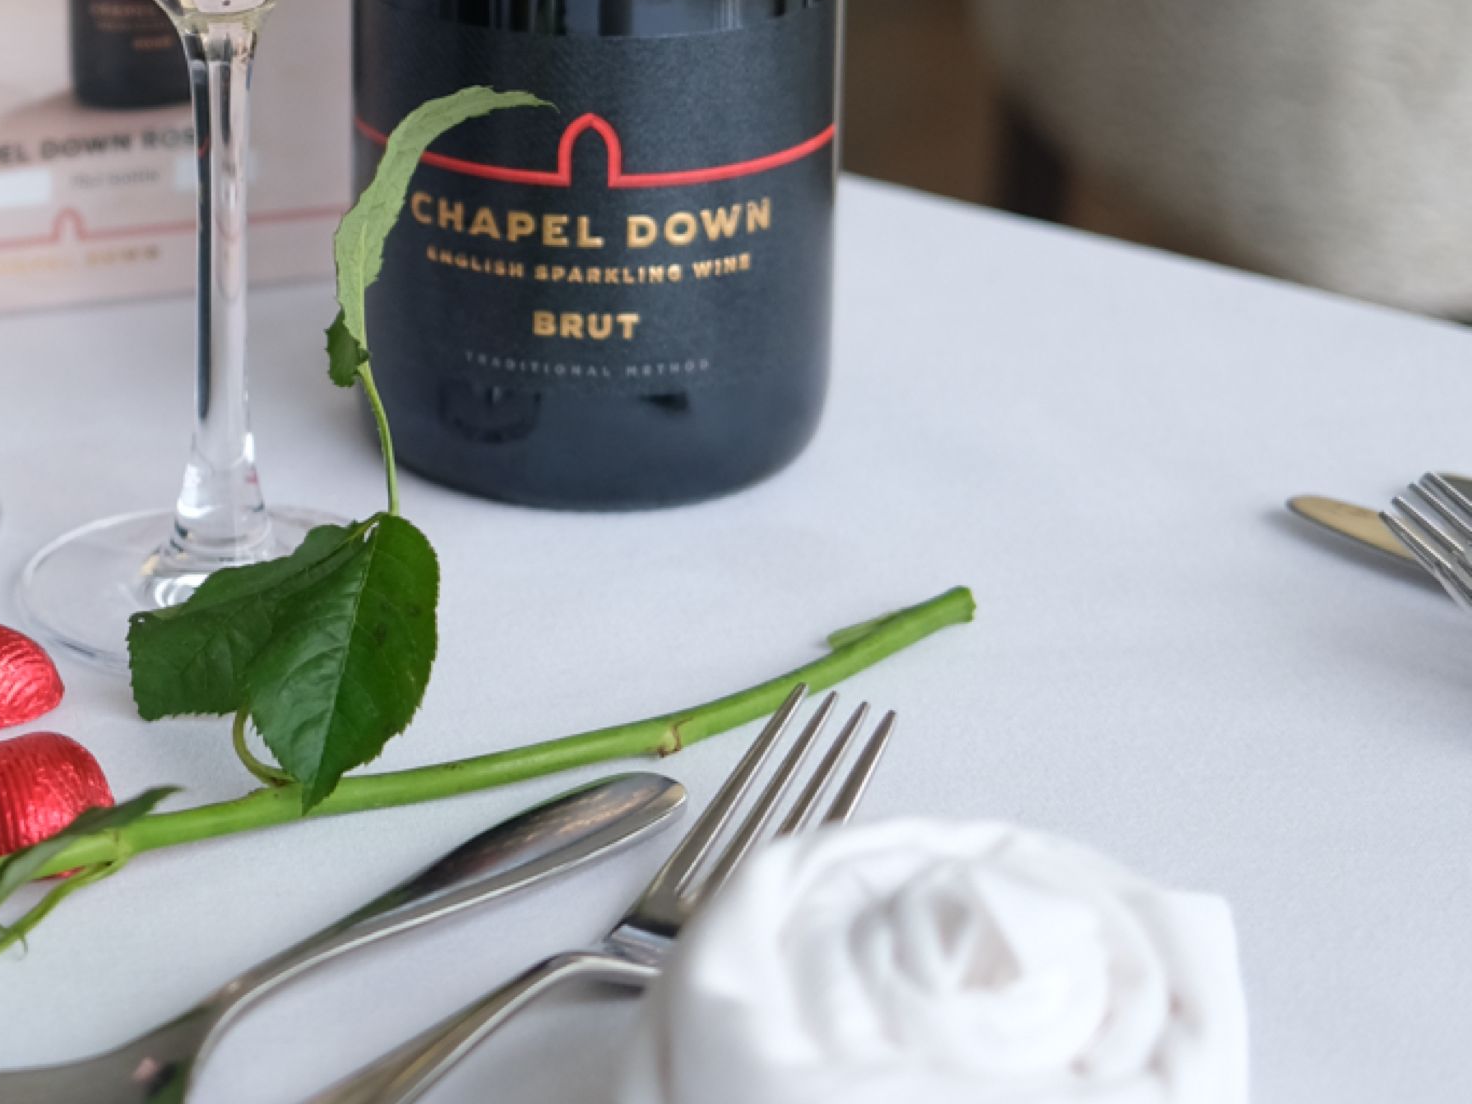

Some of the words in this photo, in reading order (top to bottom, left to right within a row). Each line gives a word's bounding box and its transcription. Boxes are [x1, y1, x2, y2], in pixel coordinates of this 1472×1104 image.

[410, 191, 605, 248] CHAPEL
[626, 196, 772, 248] DOWN
[426, 244, 525, 279] ENGLISH
[533, 262, 683, 285] SPARKLING
[691, 251, 751, 280] WINE
[532, 310, 641, 341] BRUT
